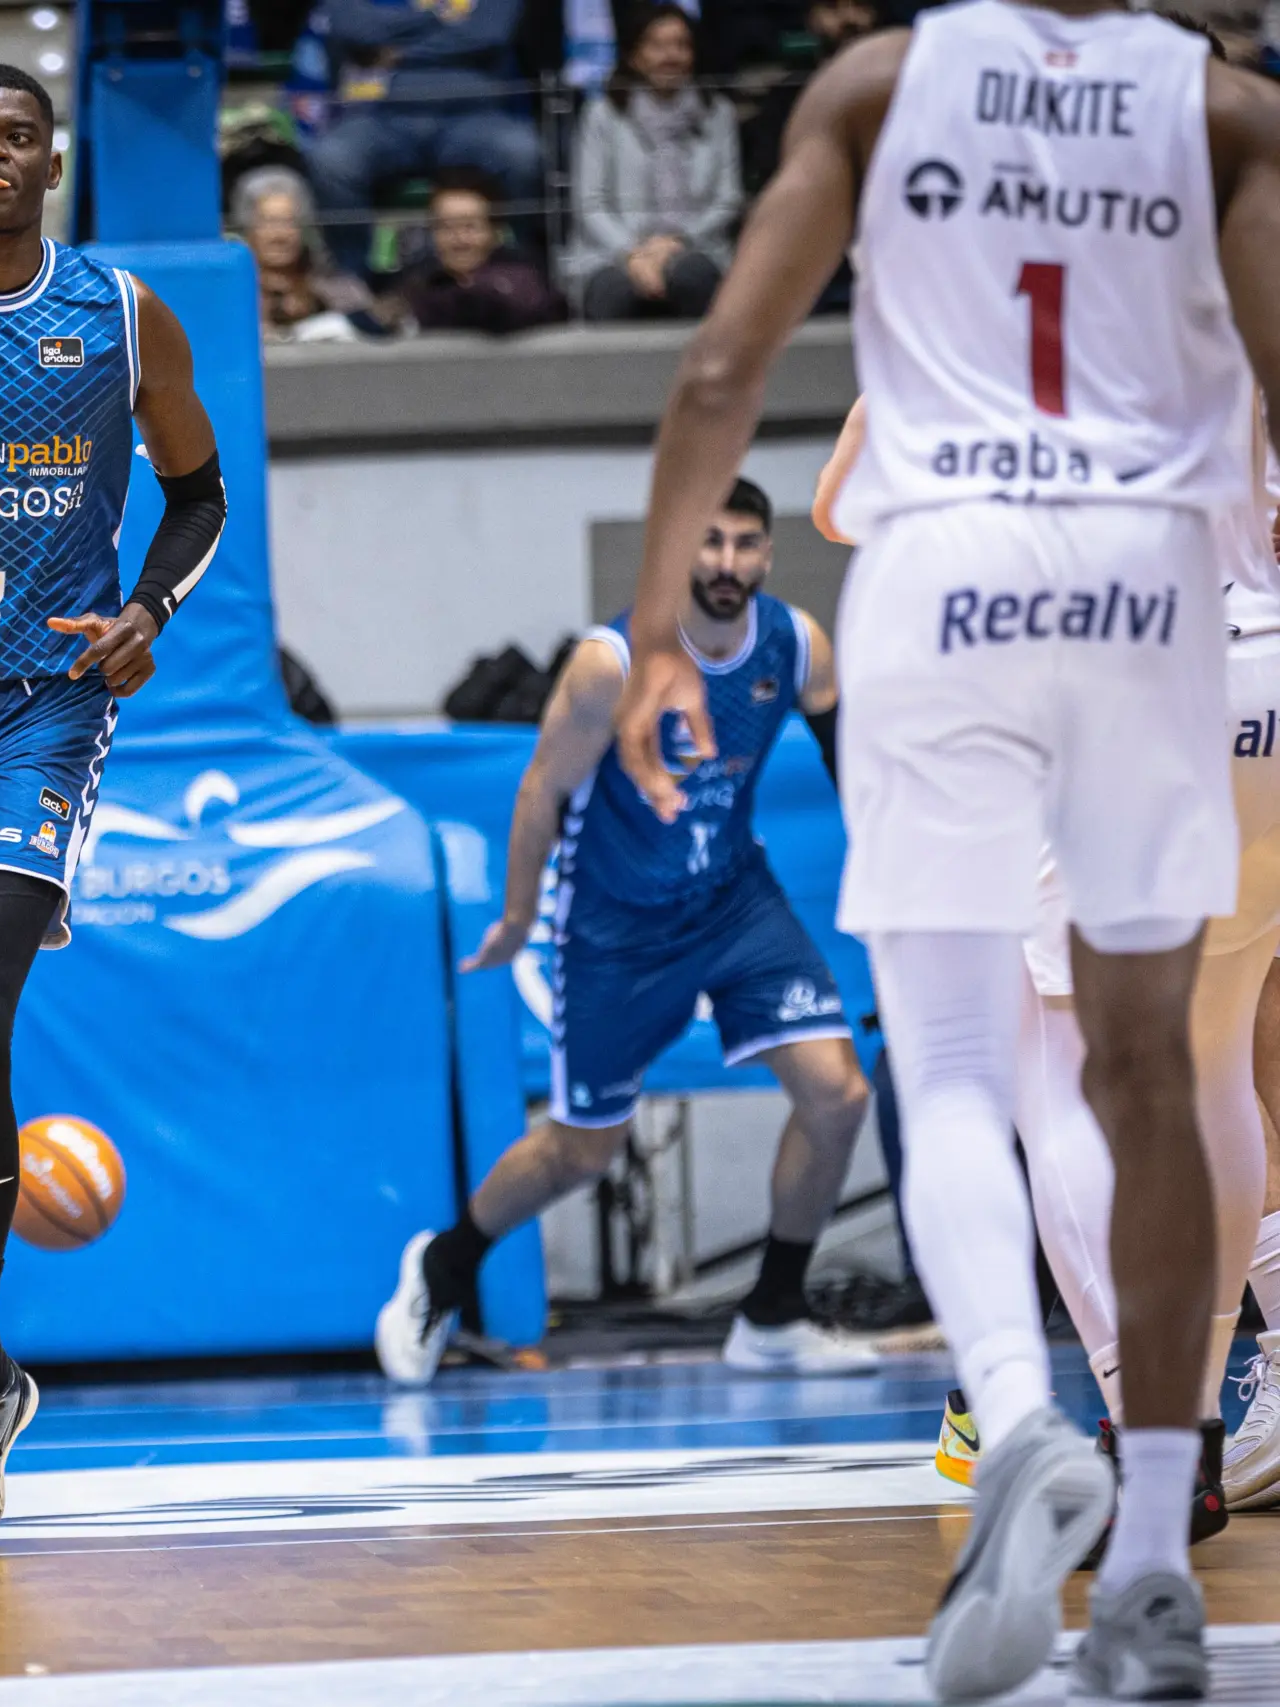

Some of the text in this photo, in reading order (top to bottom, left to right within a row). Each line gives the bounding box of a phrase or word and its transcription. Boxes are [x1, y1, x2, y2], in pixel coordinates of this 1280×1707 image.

[976, 68, 1138, 138] DIAKITE
[980, 178, 1182, 240] AMUTIO
[43, 345, 61, 356] liga
[43, 354, 81, 363] endesa
[1014, 262, 1066, 418] 1
[932, 430, 1091, 484] araba
[939, 579, 1178, 655] Recalvi
